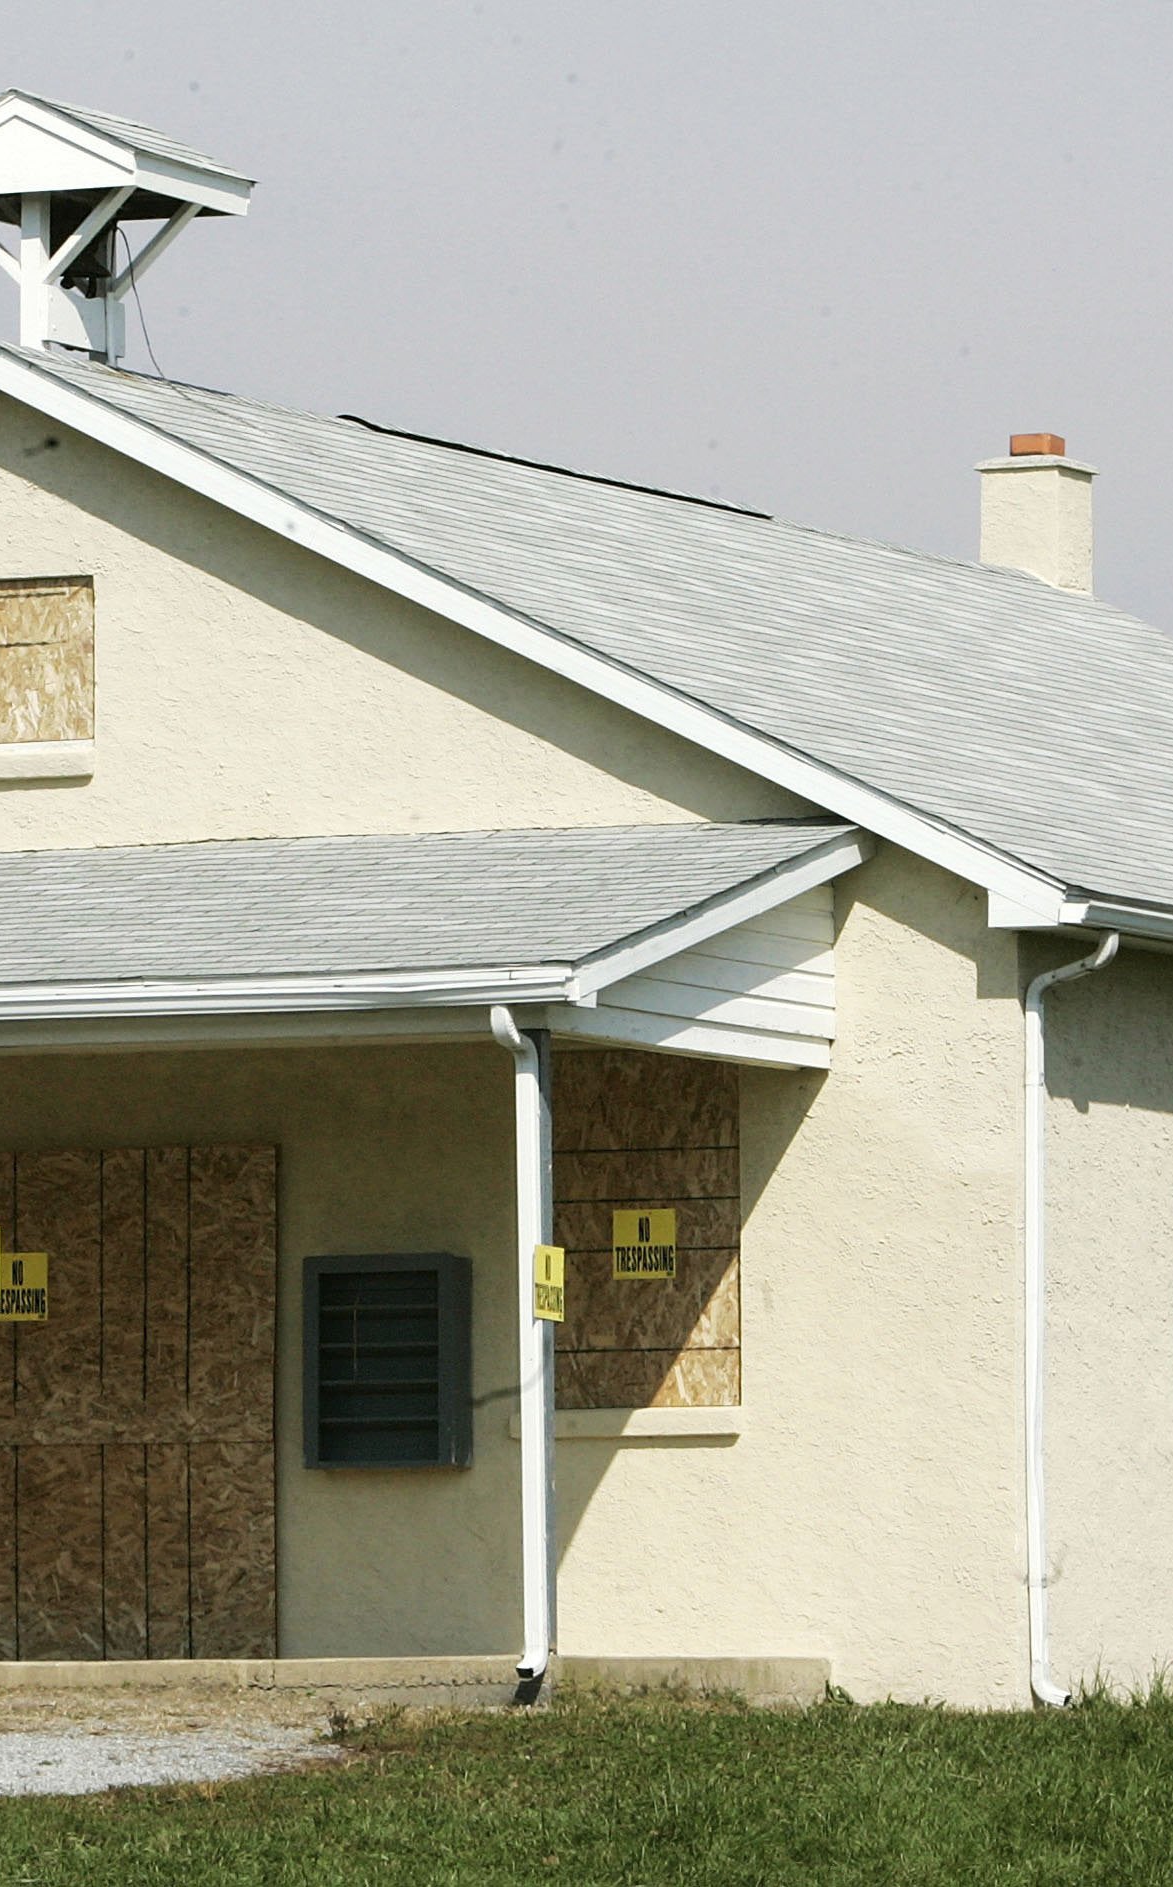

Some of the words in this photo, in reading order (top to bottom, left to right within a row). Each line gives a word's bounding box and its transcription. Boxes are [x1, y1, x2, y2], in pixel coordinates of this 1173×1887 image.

[638, 1217, 651, 1242] NO
[11, 1259, 24, 1285] NO
[615, 1246, 674, 1273] TRESPASSING
